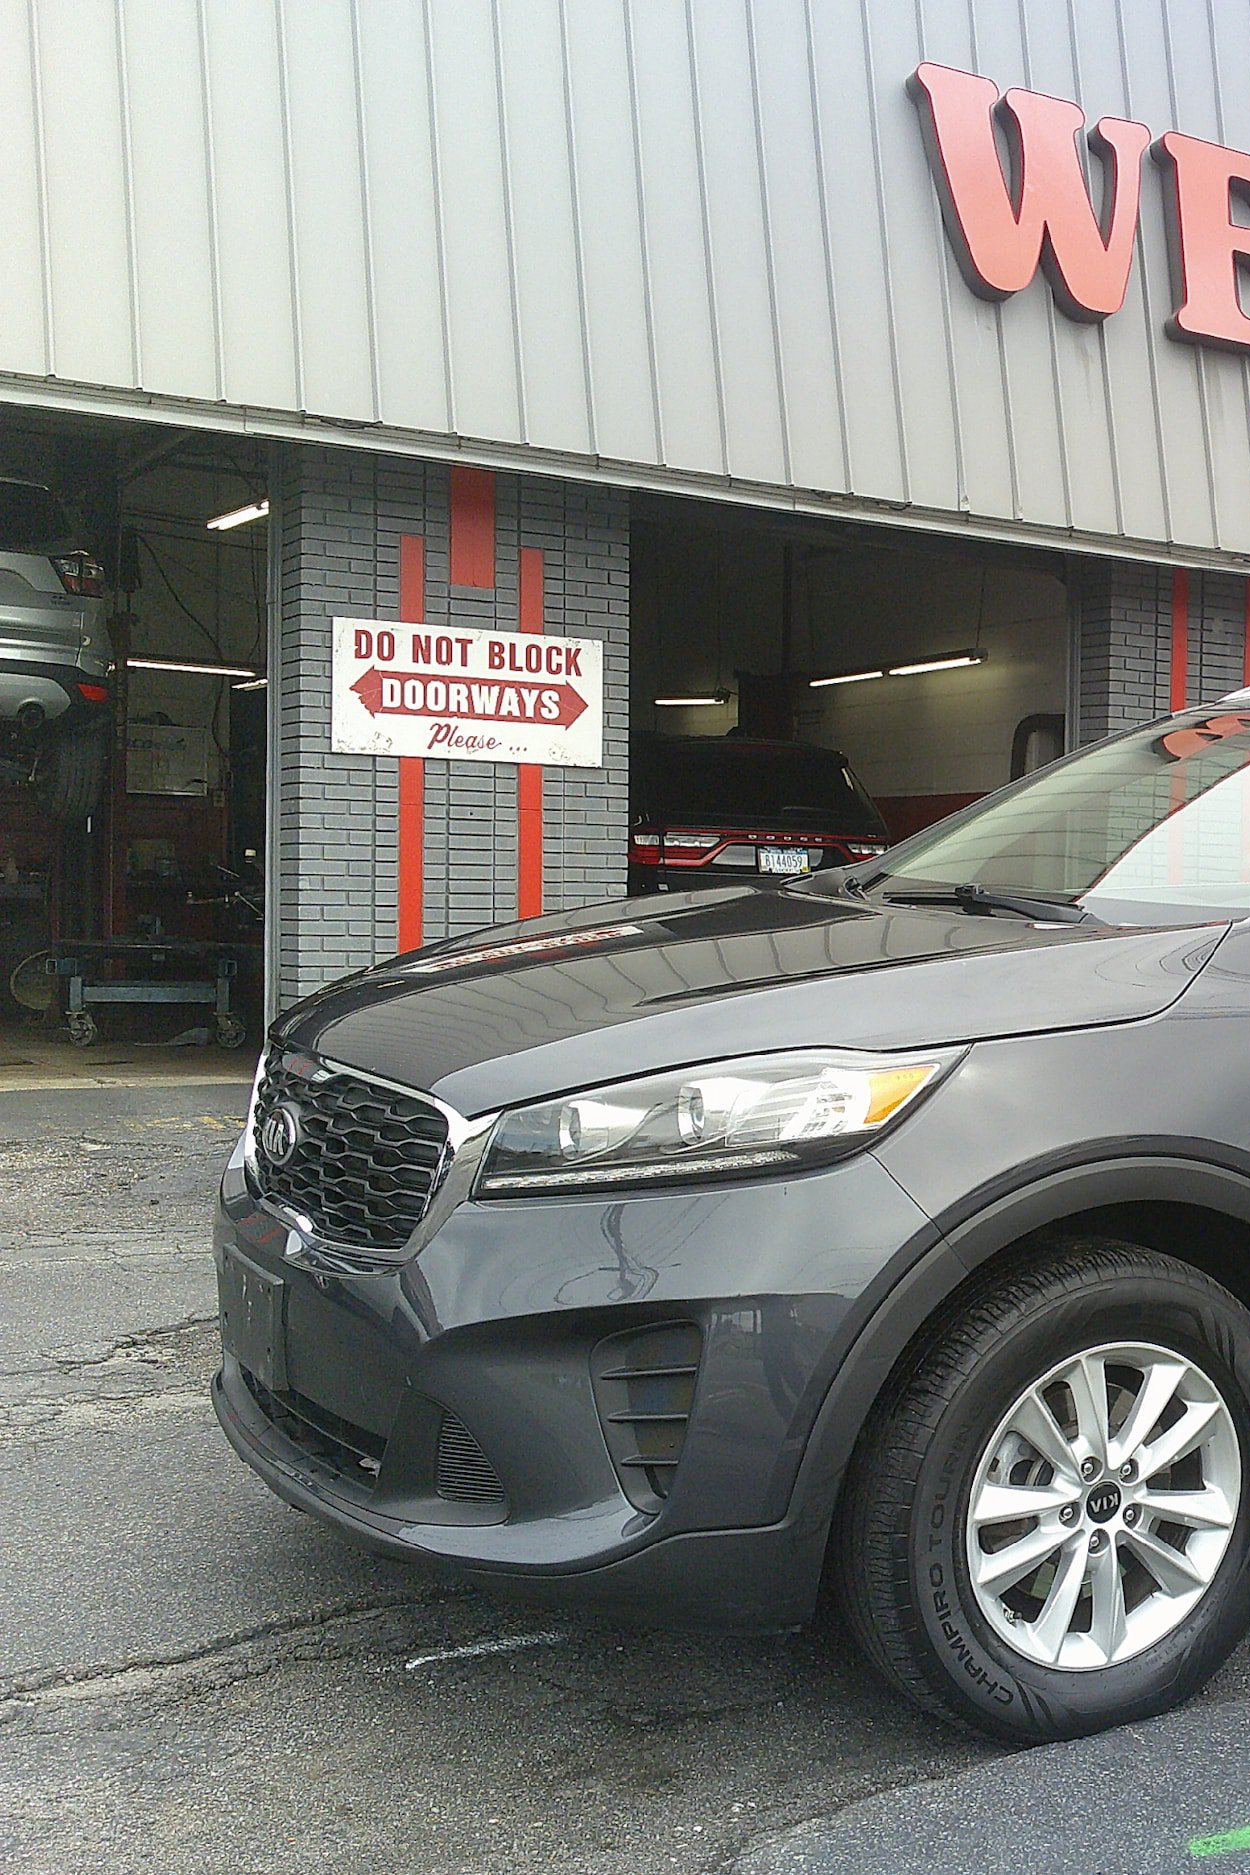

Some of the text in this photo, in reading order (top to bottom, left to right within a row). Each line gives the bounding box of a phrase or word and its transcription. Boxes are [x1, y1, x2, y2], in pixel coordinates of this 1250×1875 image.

[354, 629, 582, 677] DO NOT BLOCK
[381, 677, 561, 720] DOORWAYS
[427, 722, 502, 750] Please
[1090, 1492, 1119, 1513] KIA
[928, 1562, 1015, 1707] CHAMPIRO
